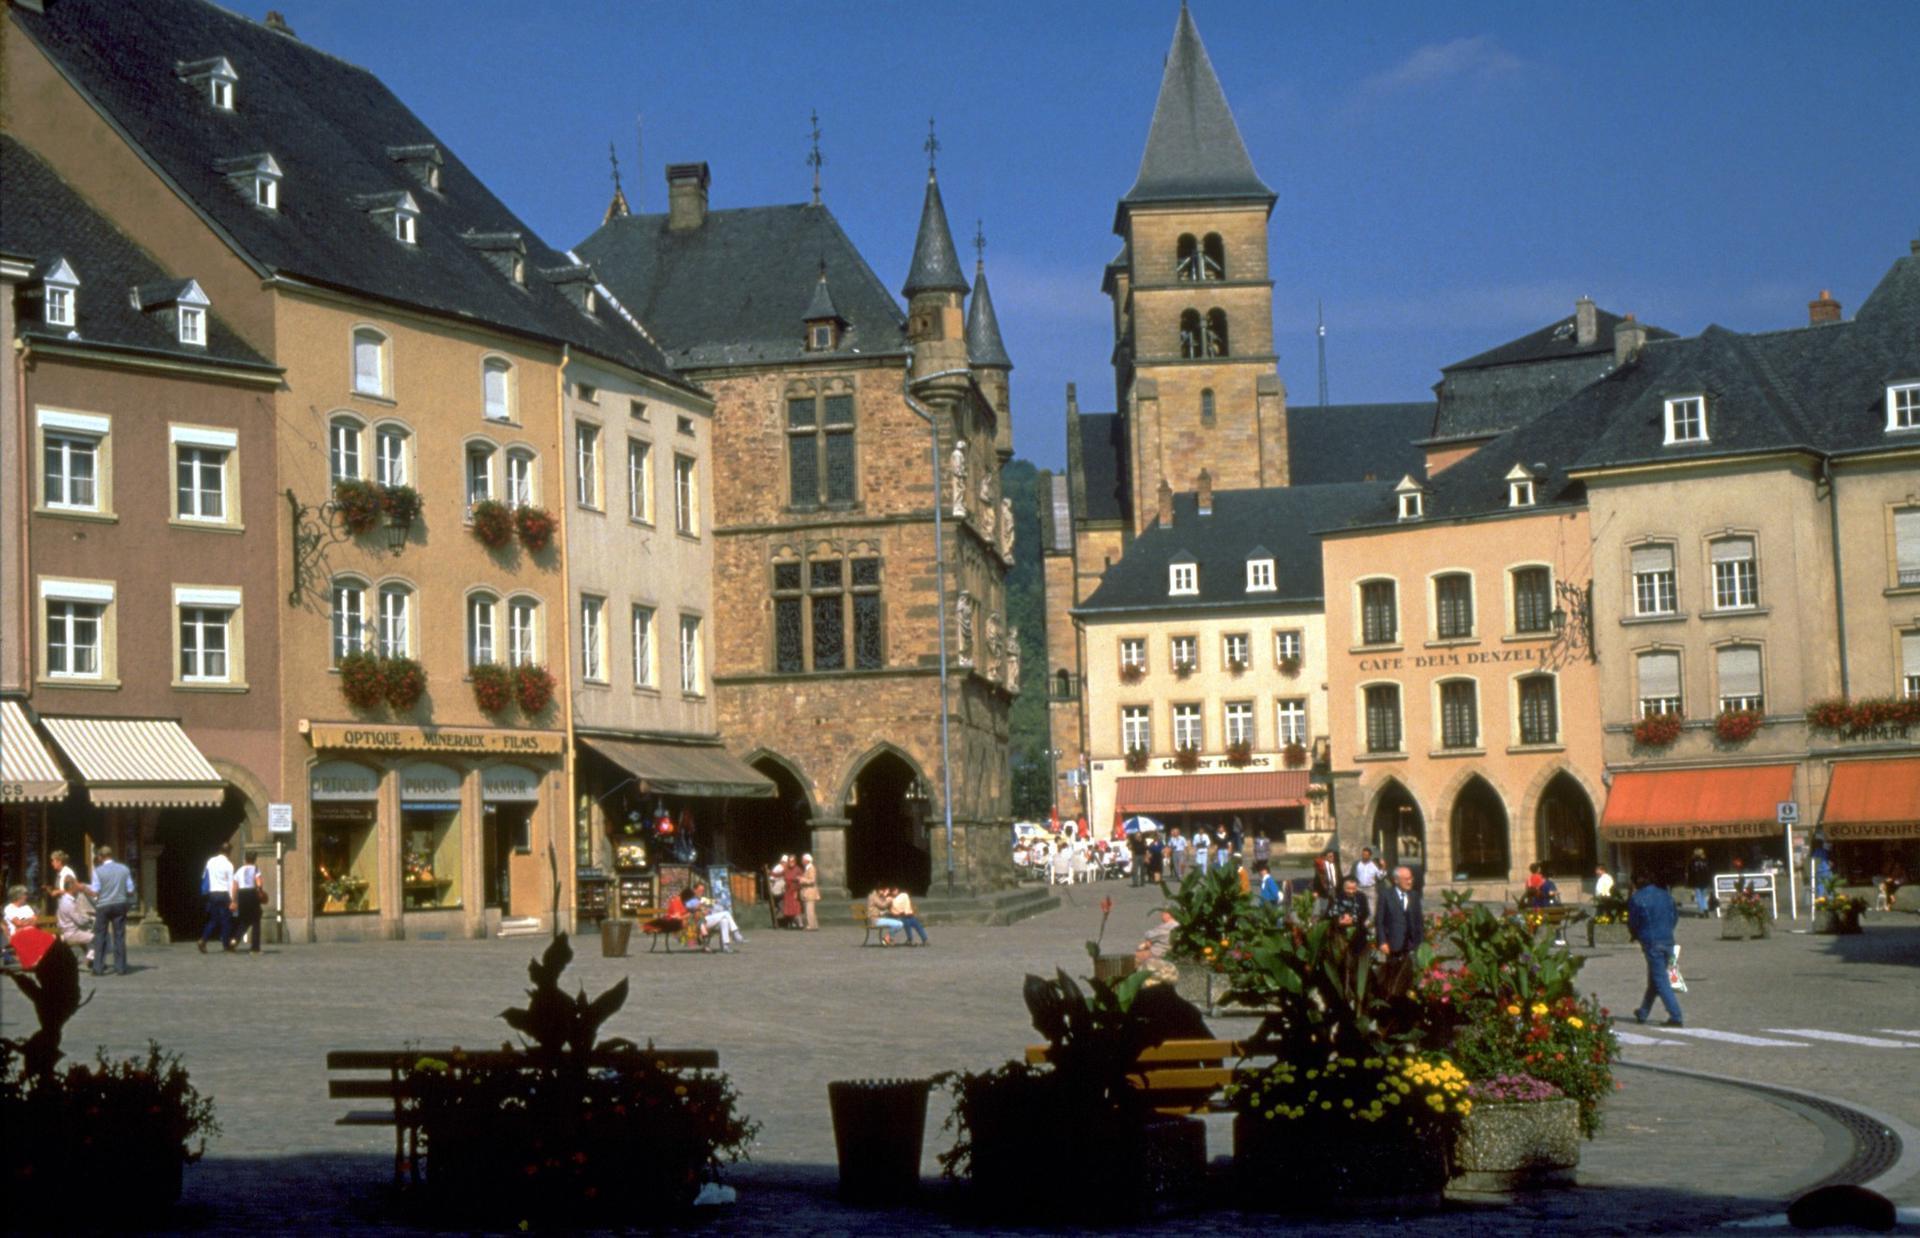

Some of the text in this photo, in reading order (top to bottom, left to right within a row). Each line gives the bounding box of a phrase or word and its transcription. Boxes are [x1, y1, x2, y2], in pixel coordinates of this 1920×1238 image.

[1359, 656, 1402, 671] CAFE
[1467, 648, 1548, 664] DENZELT
[344, 730, 539, 750] OPTIQUE MINERAUX FILMS
